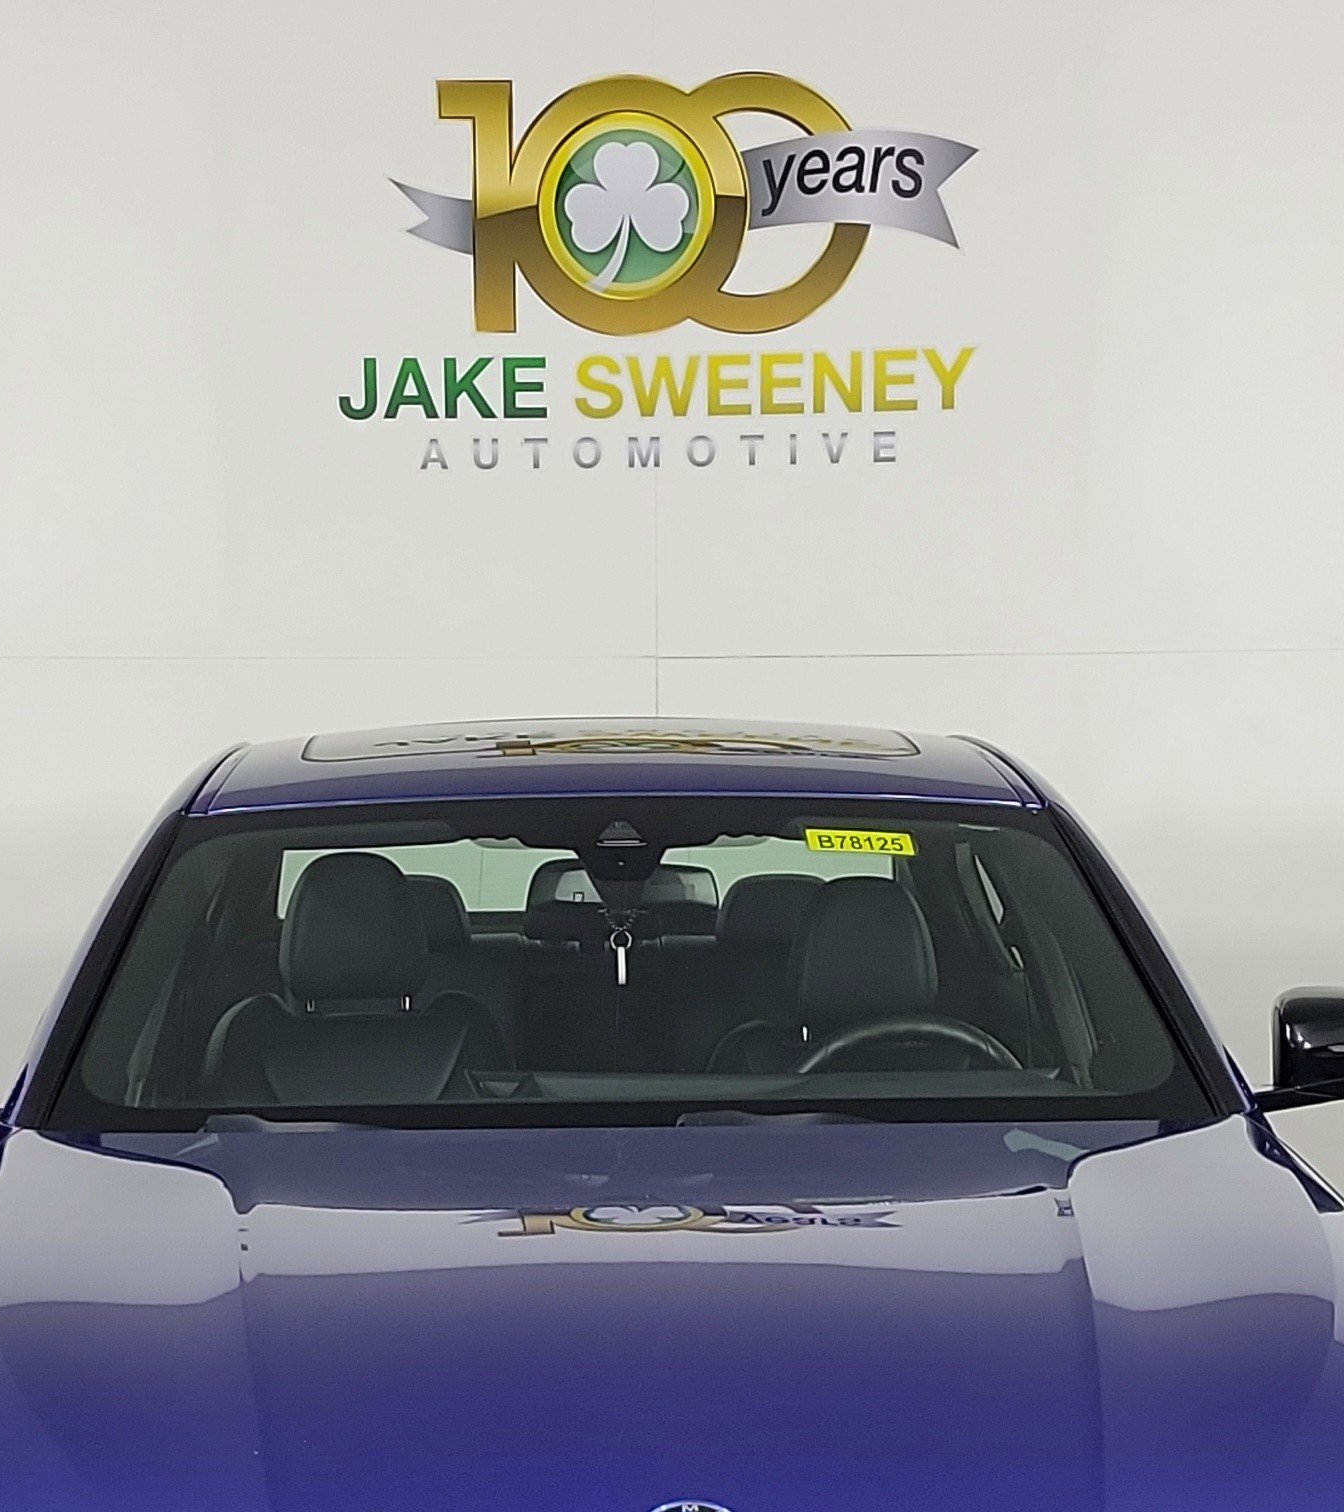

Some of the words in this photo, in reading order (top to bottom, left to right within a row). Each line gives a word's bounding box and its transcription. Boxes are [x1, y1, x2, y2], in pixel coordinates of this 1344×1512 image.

[436, 70, 871, 337] 100
[761, 145, 926, 218] years
[338, 356, 549, 421] JAKE
[574, 346, 977, 419] SWEENEY
[420, 431, 899, 471] AUTOMOTIVE
[817, 834, 904, 852] B78125
